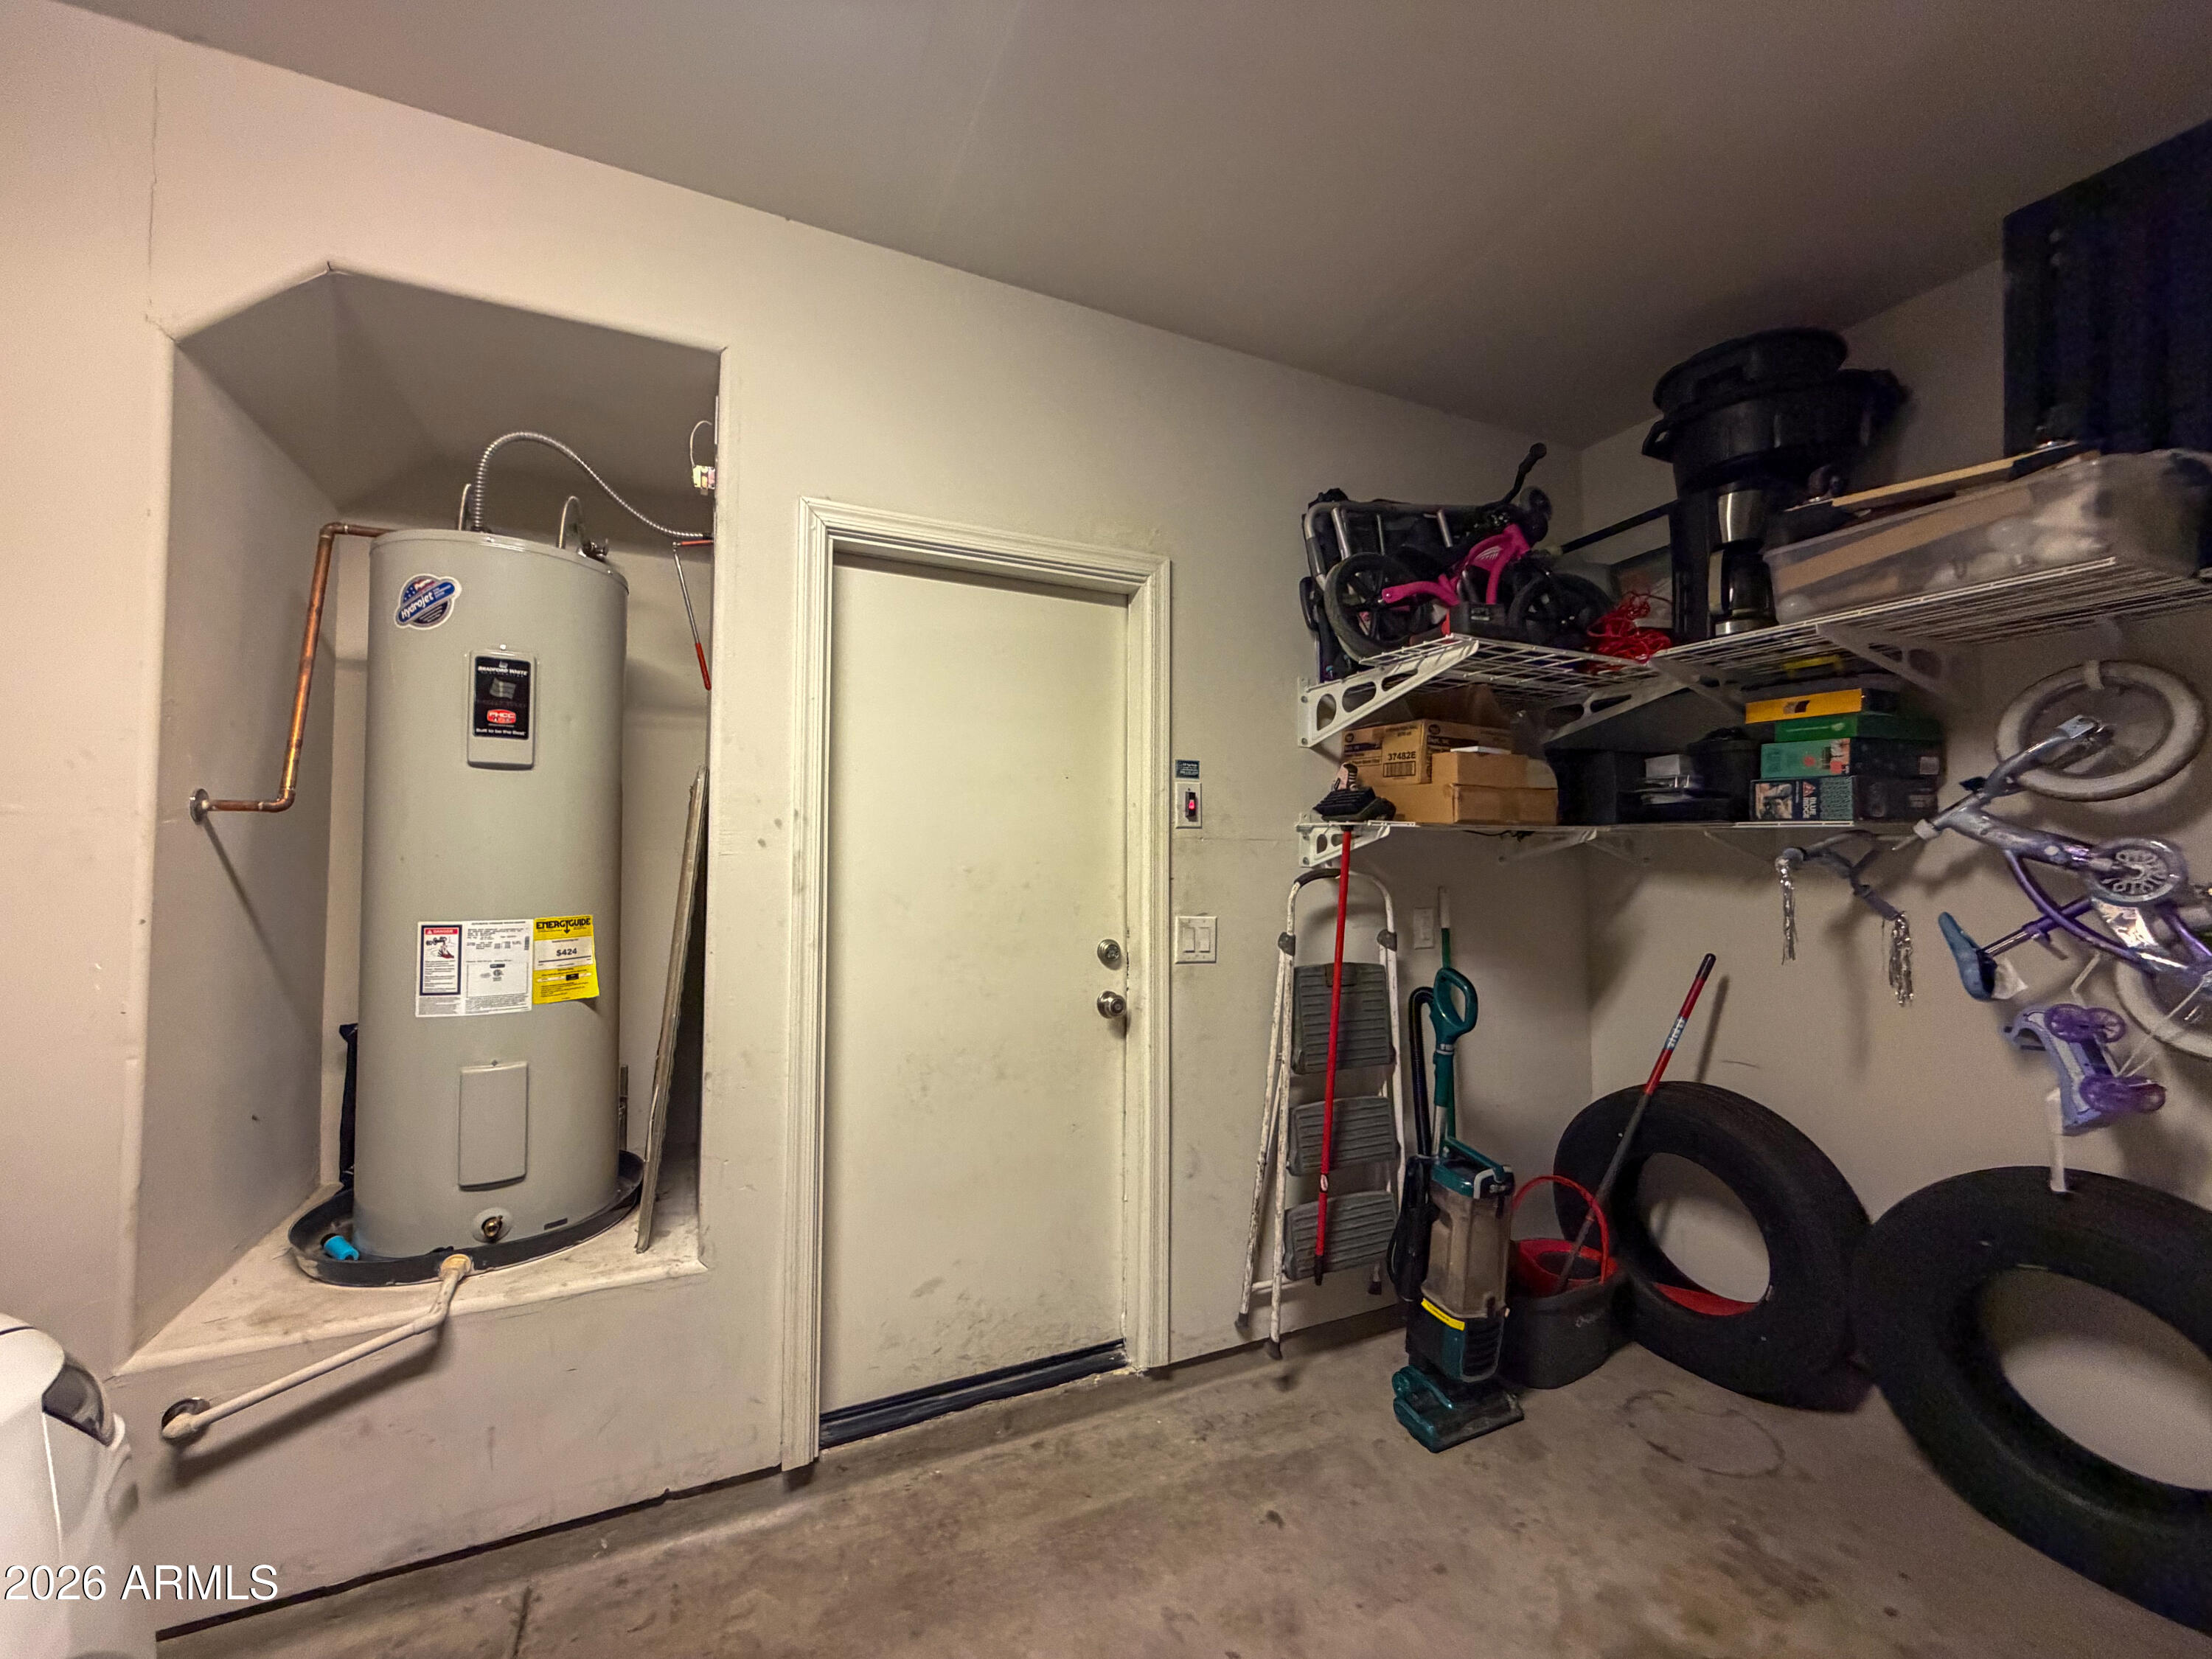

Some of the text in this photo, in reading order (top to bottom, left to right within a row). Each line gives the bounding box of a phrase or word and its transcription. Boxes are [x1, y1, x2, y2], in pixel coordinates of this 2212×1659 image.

[509, 668, 528, 676] WHITE
[1809, 796, 1818, 815] BLUE
[556, 947, 577, 956] $424
